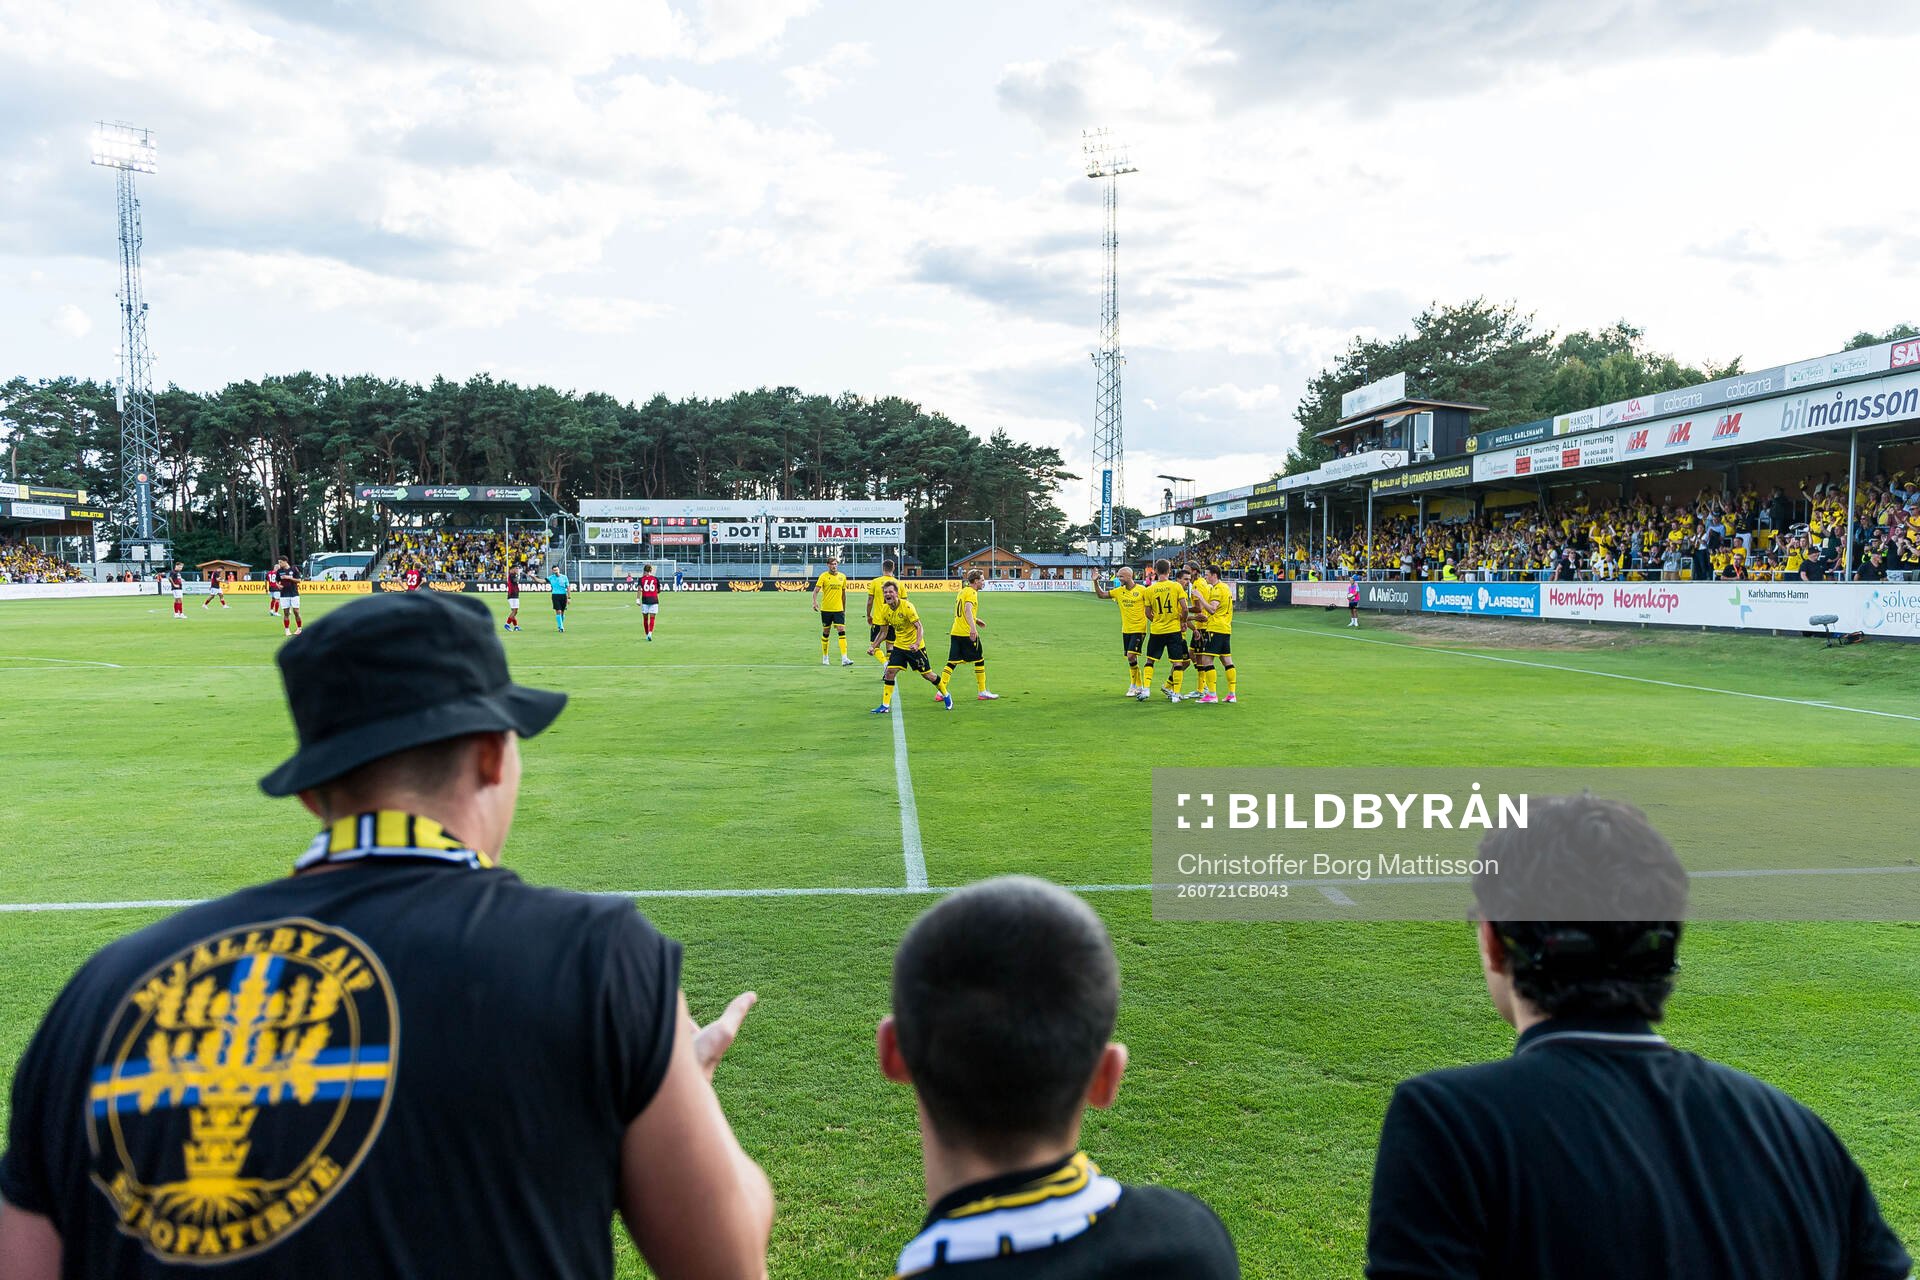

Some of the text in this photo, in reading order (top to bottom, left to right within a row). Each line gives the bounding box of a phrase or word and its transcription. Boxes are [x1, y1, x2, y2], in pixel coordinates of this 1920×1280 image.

[1893, 342, 1920, 367] SA
[1726, 377, 1773, 400] colorama
[1627, 399, 1641, 413] ICA
[1663, 391, 1703, 412] colorama
[1779, 386, 1920, 433] bilmånsson
[1495, 434, 1513, 444] HOTELL
[1514, 427, 1544, 440] KARLSHAMN
[1562, 439, 1578, 450] ALLT
[1583, 434, 1614, 446] murning
[1515, 448, 1529, 457] ALLT
[1533, 443, 1560, 454] murning
[1584, 455, 1614, 465] KARLSHAMN
[1409, 470, 1433, 485] UTANFÖR
[1433, 464, 1470, 480] REKTANGELN
[1533, 464, 1560, 473] KARLSHAMN
[778, 526, 806, 538] BLT
[407, 574, 417, 586] 23
[581, 583, 591, 591] VI
[594, 583, 614, 591] DET
[644, 580, 655, 591] 66
[238, 584, 267, 592] ANDRA
[1748, 589, 1809, 599] Karlshamns Hamn
[1156, 593, 1173, 614] 14
[1435, 594, 1473, 606] LARSSON
[1488, 596, 1534, 609] LARSSON
[1549, 587, 1604, 611] Hemköp
[1613, 587, 1679, 613] Hemköp
